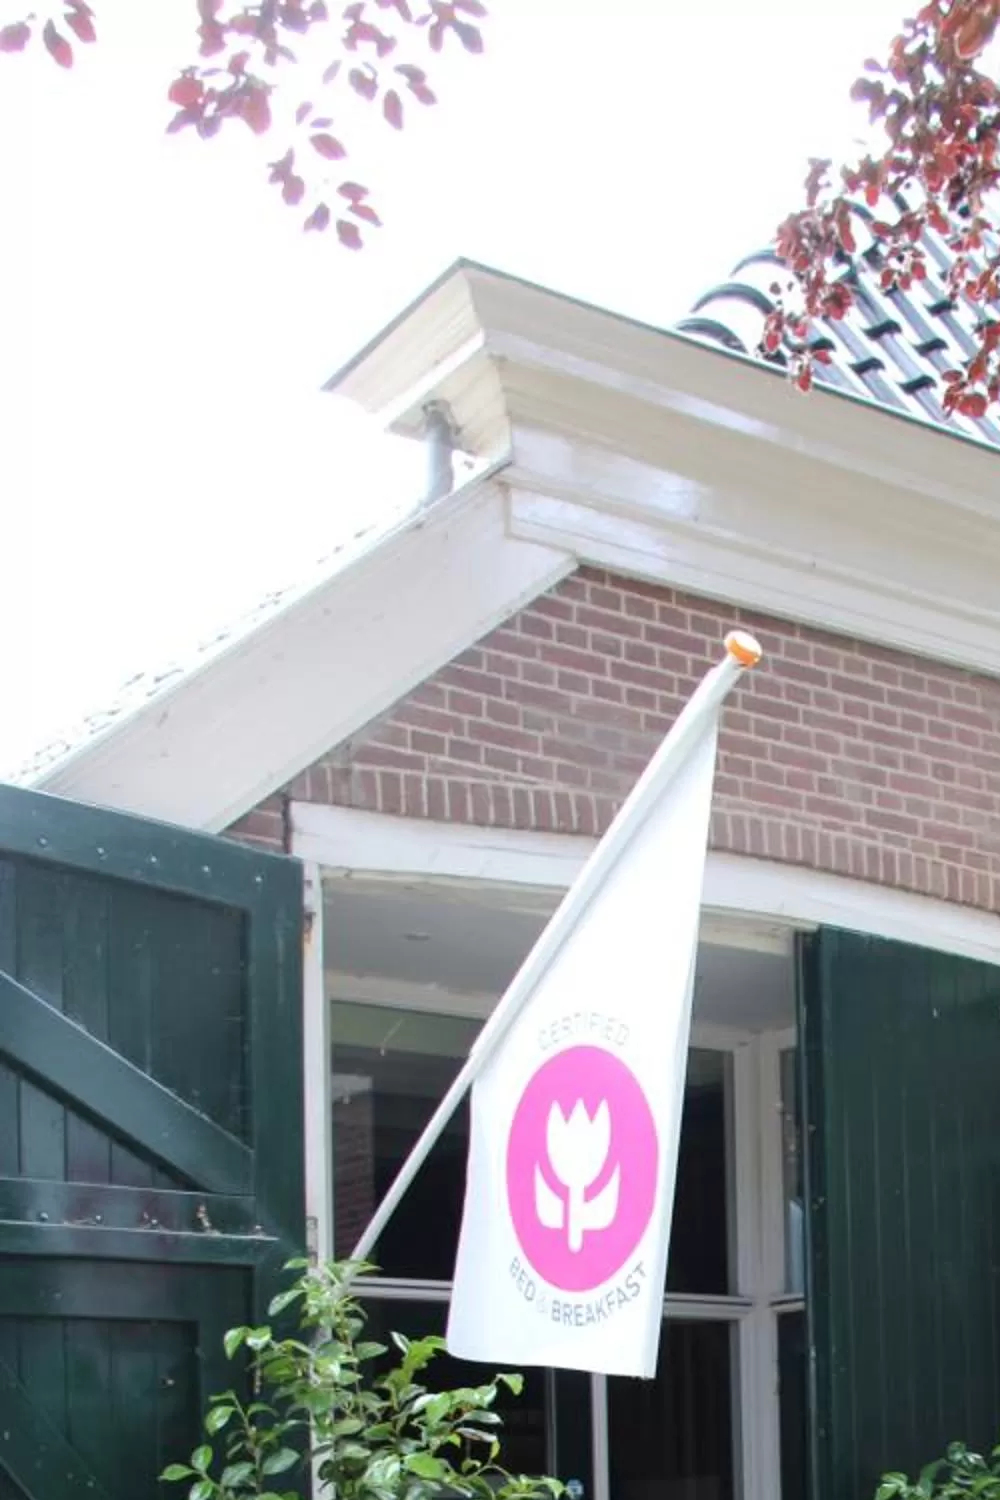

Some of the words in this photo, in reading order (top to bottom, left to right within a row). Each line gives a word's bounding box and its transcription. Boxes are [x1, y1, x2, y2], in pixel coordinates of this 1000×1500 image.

[537, 1011, 630, 1051] CERTIFIED
[508, 1256, 537, 1302] BED
[551, 1260, 648, 1327] BREAKFAST
